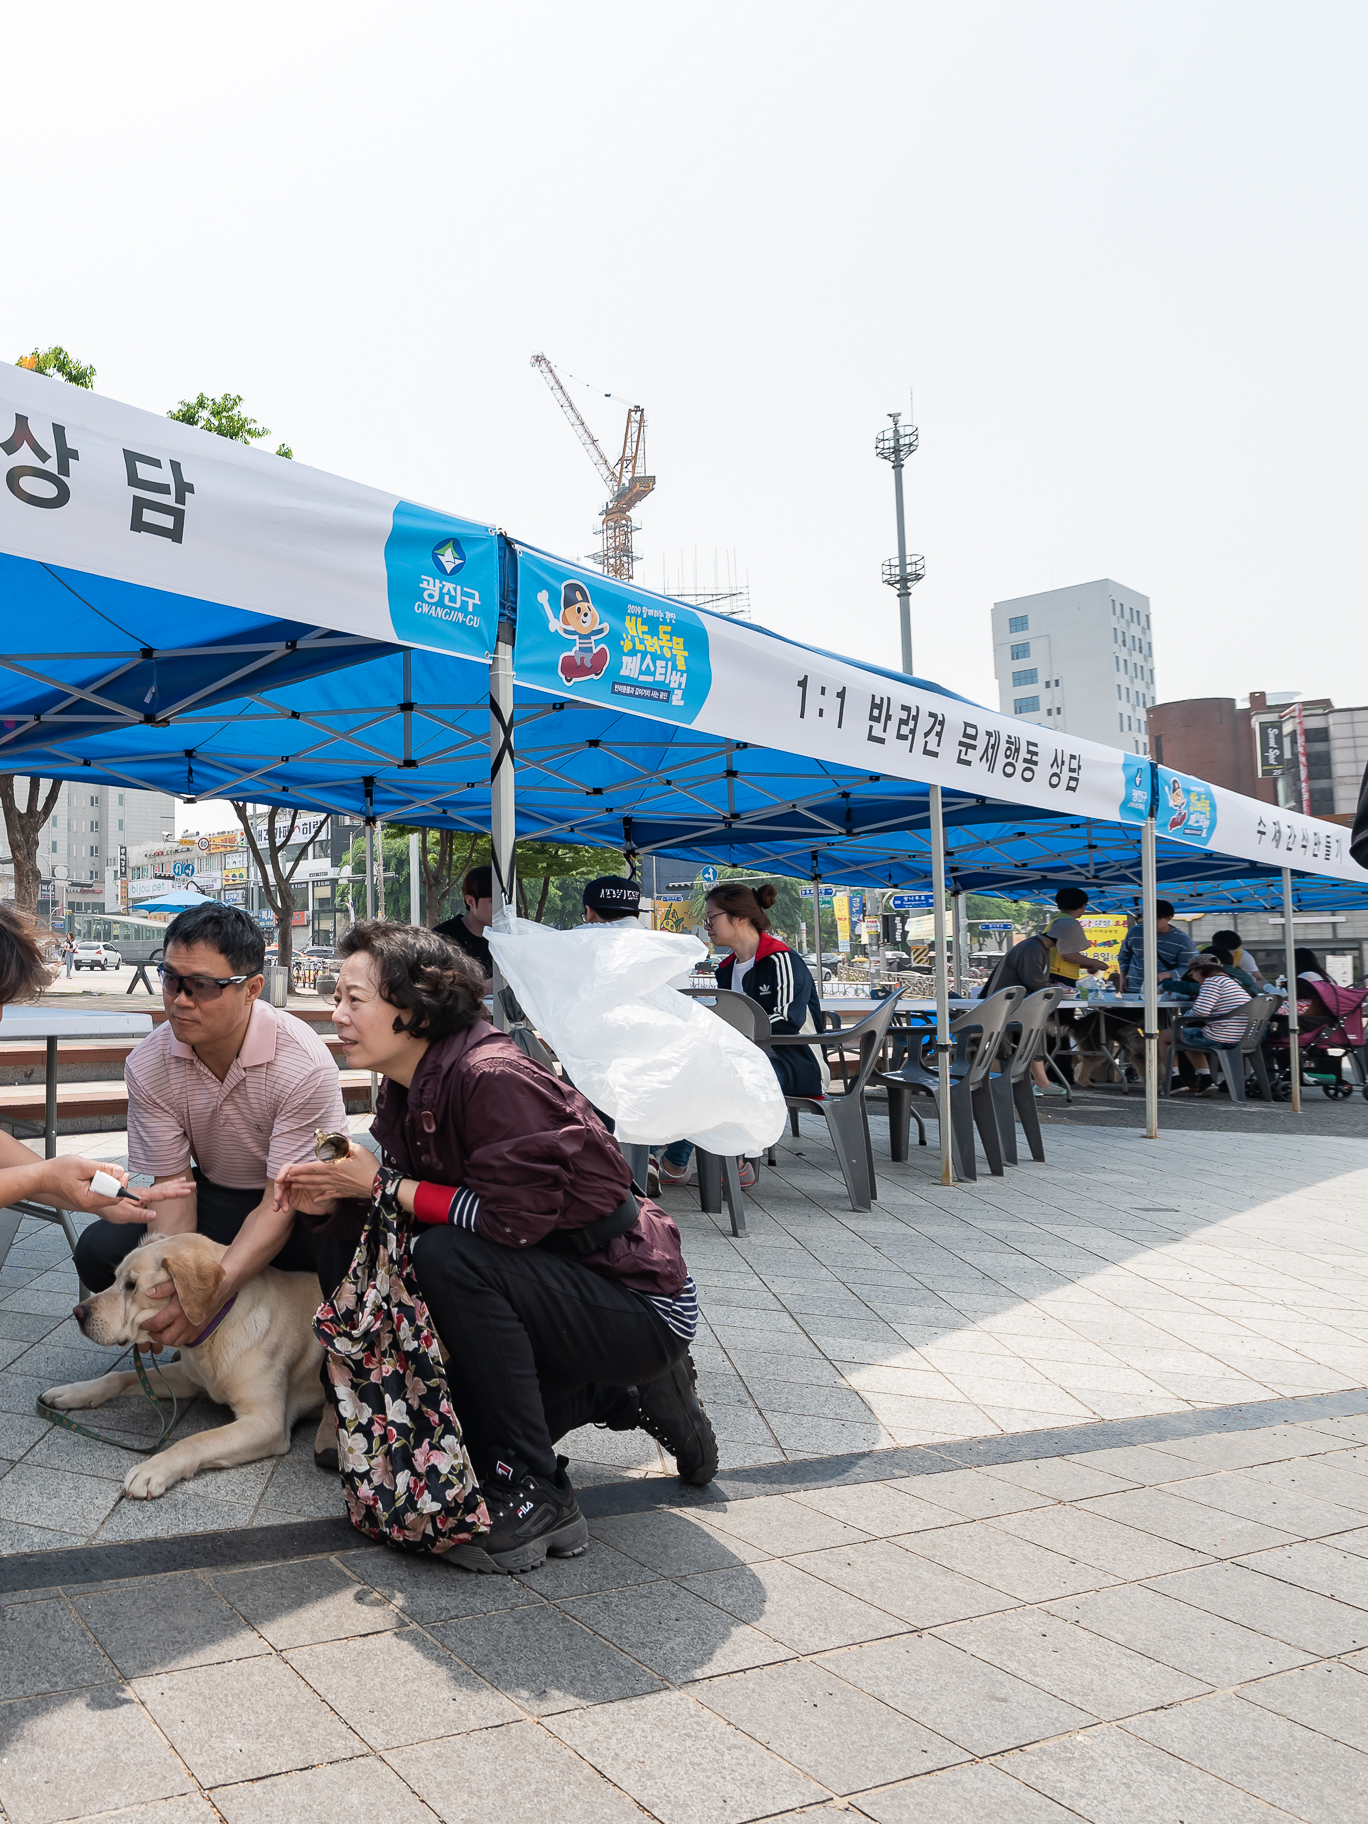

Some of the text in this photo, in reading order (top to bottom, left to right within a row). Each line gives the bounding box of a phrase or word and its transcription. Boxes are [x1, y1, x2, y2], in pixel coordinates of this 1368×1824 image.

[419, 575, 481, 612] 광진구
[627, 604, 641, 615] 2019
[414, 601, 480, 628] GWANGJIN-GU
[625, 616, 688, 670] 반려동물
[619, 653, 687, 706] 페스티벌
[796, 674, 1082, 793] 1:1 반려견 문제행동 상담
[132, 883, 150, 895] bijou
[152, 882, 164, 894] pet
[516, 1501, 534, 1519] FILA
